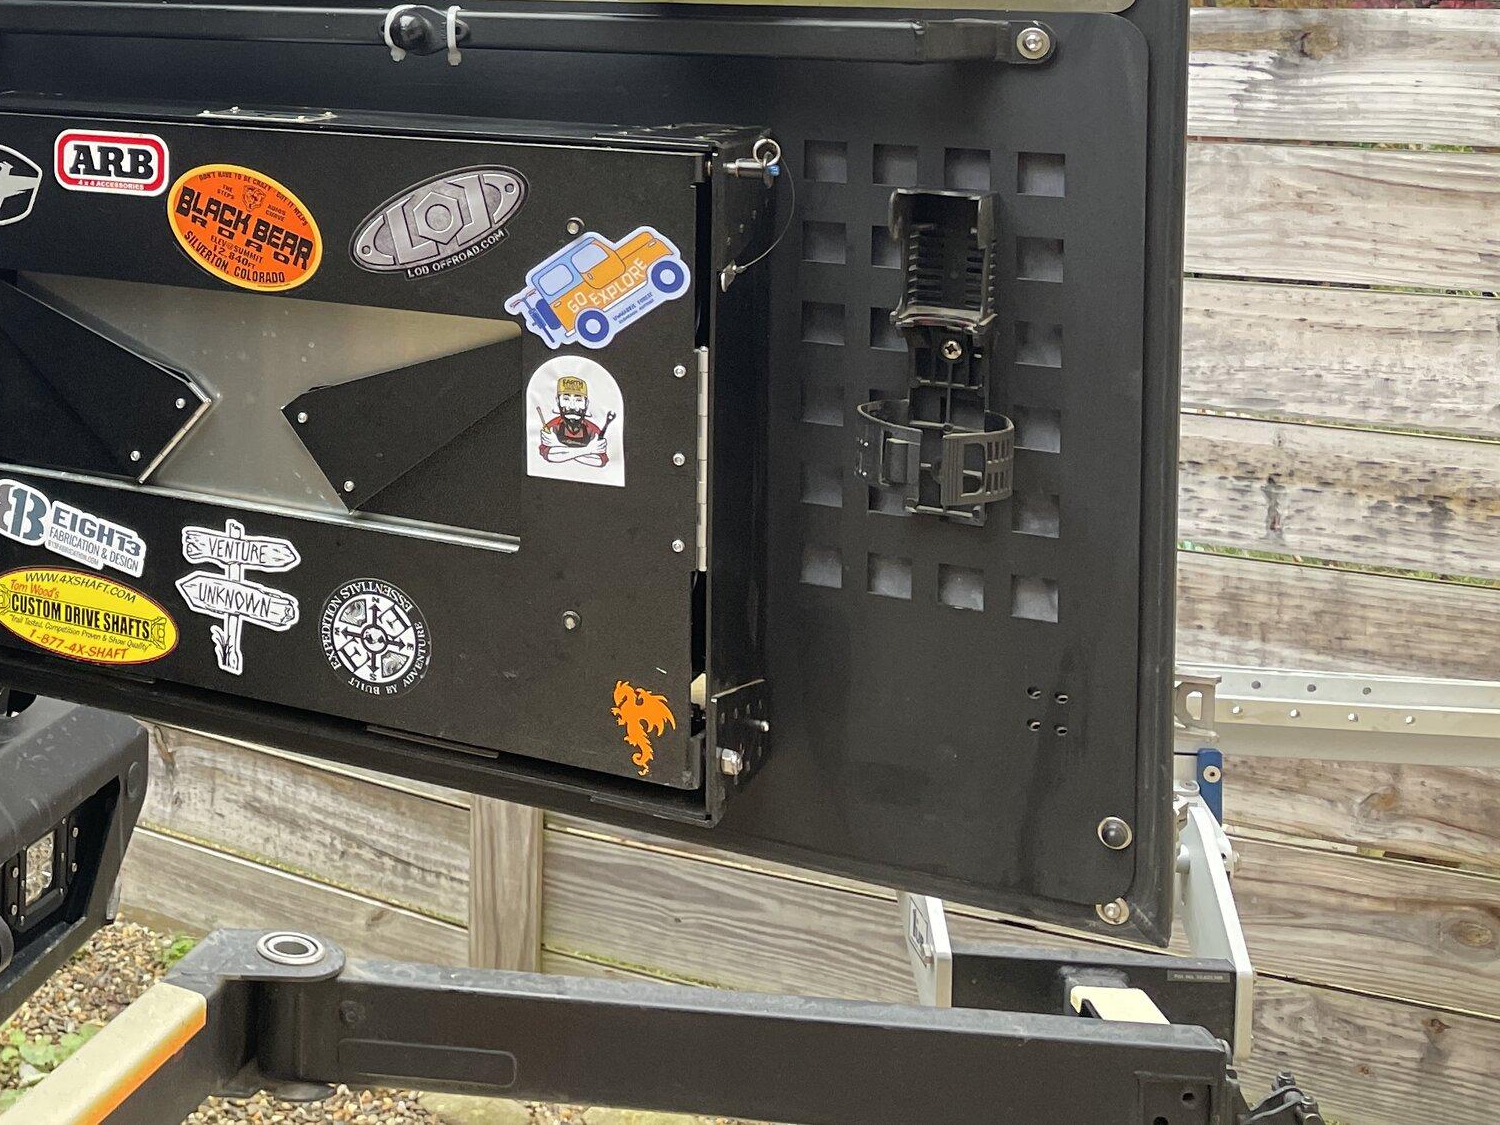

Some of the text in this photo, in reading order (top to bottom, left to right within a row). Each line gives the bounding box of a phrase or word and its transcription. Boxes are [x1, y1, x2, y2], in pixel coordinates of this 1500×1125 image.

[69, 144, 154, 179] ARB
[97, 181, 145, 191] ACCESSORIES
[253, 178, 272, 191] CRAZY
[176, 186, 314, 270] BLACK BEAR
[407, 229, 505, 278] LOD OFFROAD.COM
[234, 266, 285, 283] COLORADO
[567, 291, 588, 314] GO
[588, 258, 647, 307] EXPLORE
[49, 527, 139, 572] FABRICATION & DESIGN
[208, 537, 269, 564] VENTURE
[10, 579, 60, 599] Tom Wood's
[25, 572, 136, 604] WWW.4XSHAFT.COM
[199, 582, 272, 618] UNKNOWN
[11, 594, 150, 640] CUSTOM DRIVE SHAFTS
[45, 621, 80, 636] Competition
[81, 630, 101, 641] Proven
[108, 636, 126, 646] Show
[321, 581, 414, 670] EXPEDITION ESSENTIALS
[29, 629, 129, 659] 1-877-4X-SHAFT
[347, 677, 380, 695] BUILT
[402, 621, 427, 687] ADVENTURE
